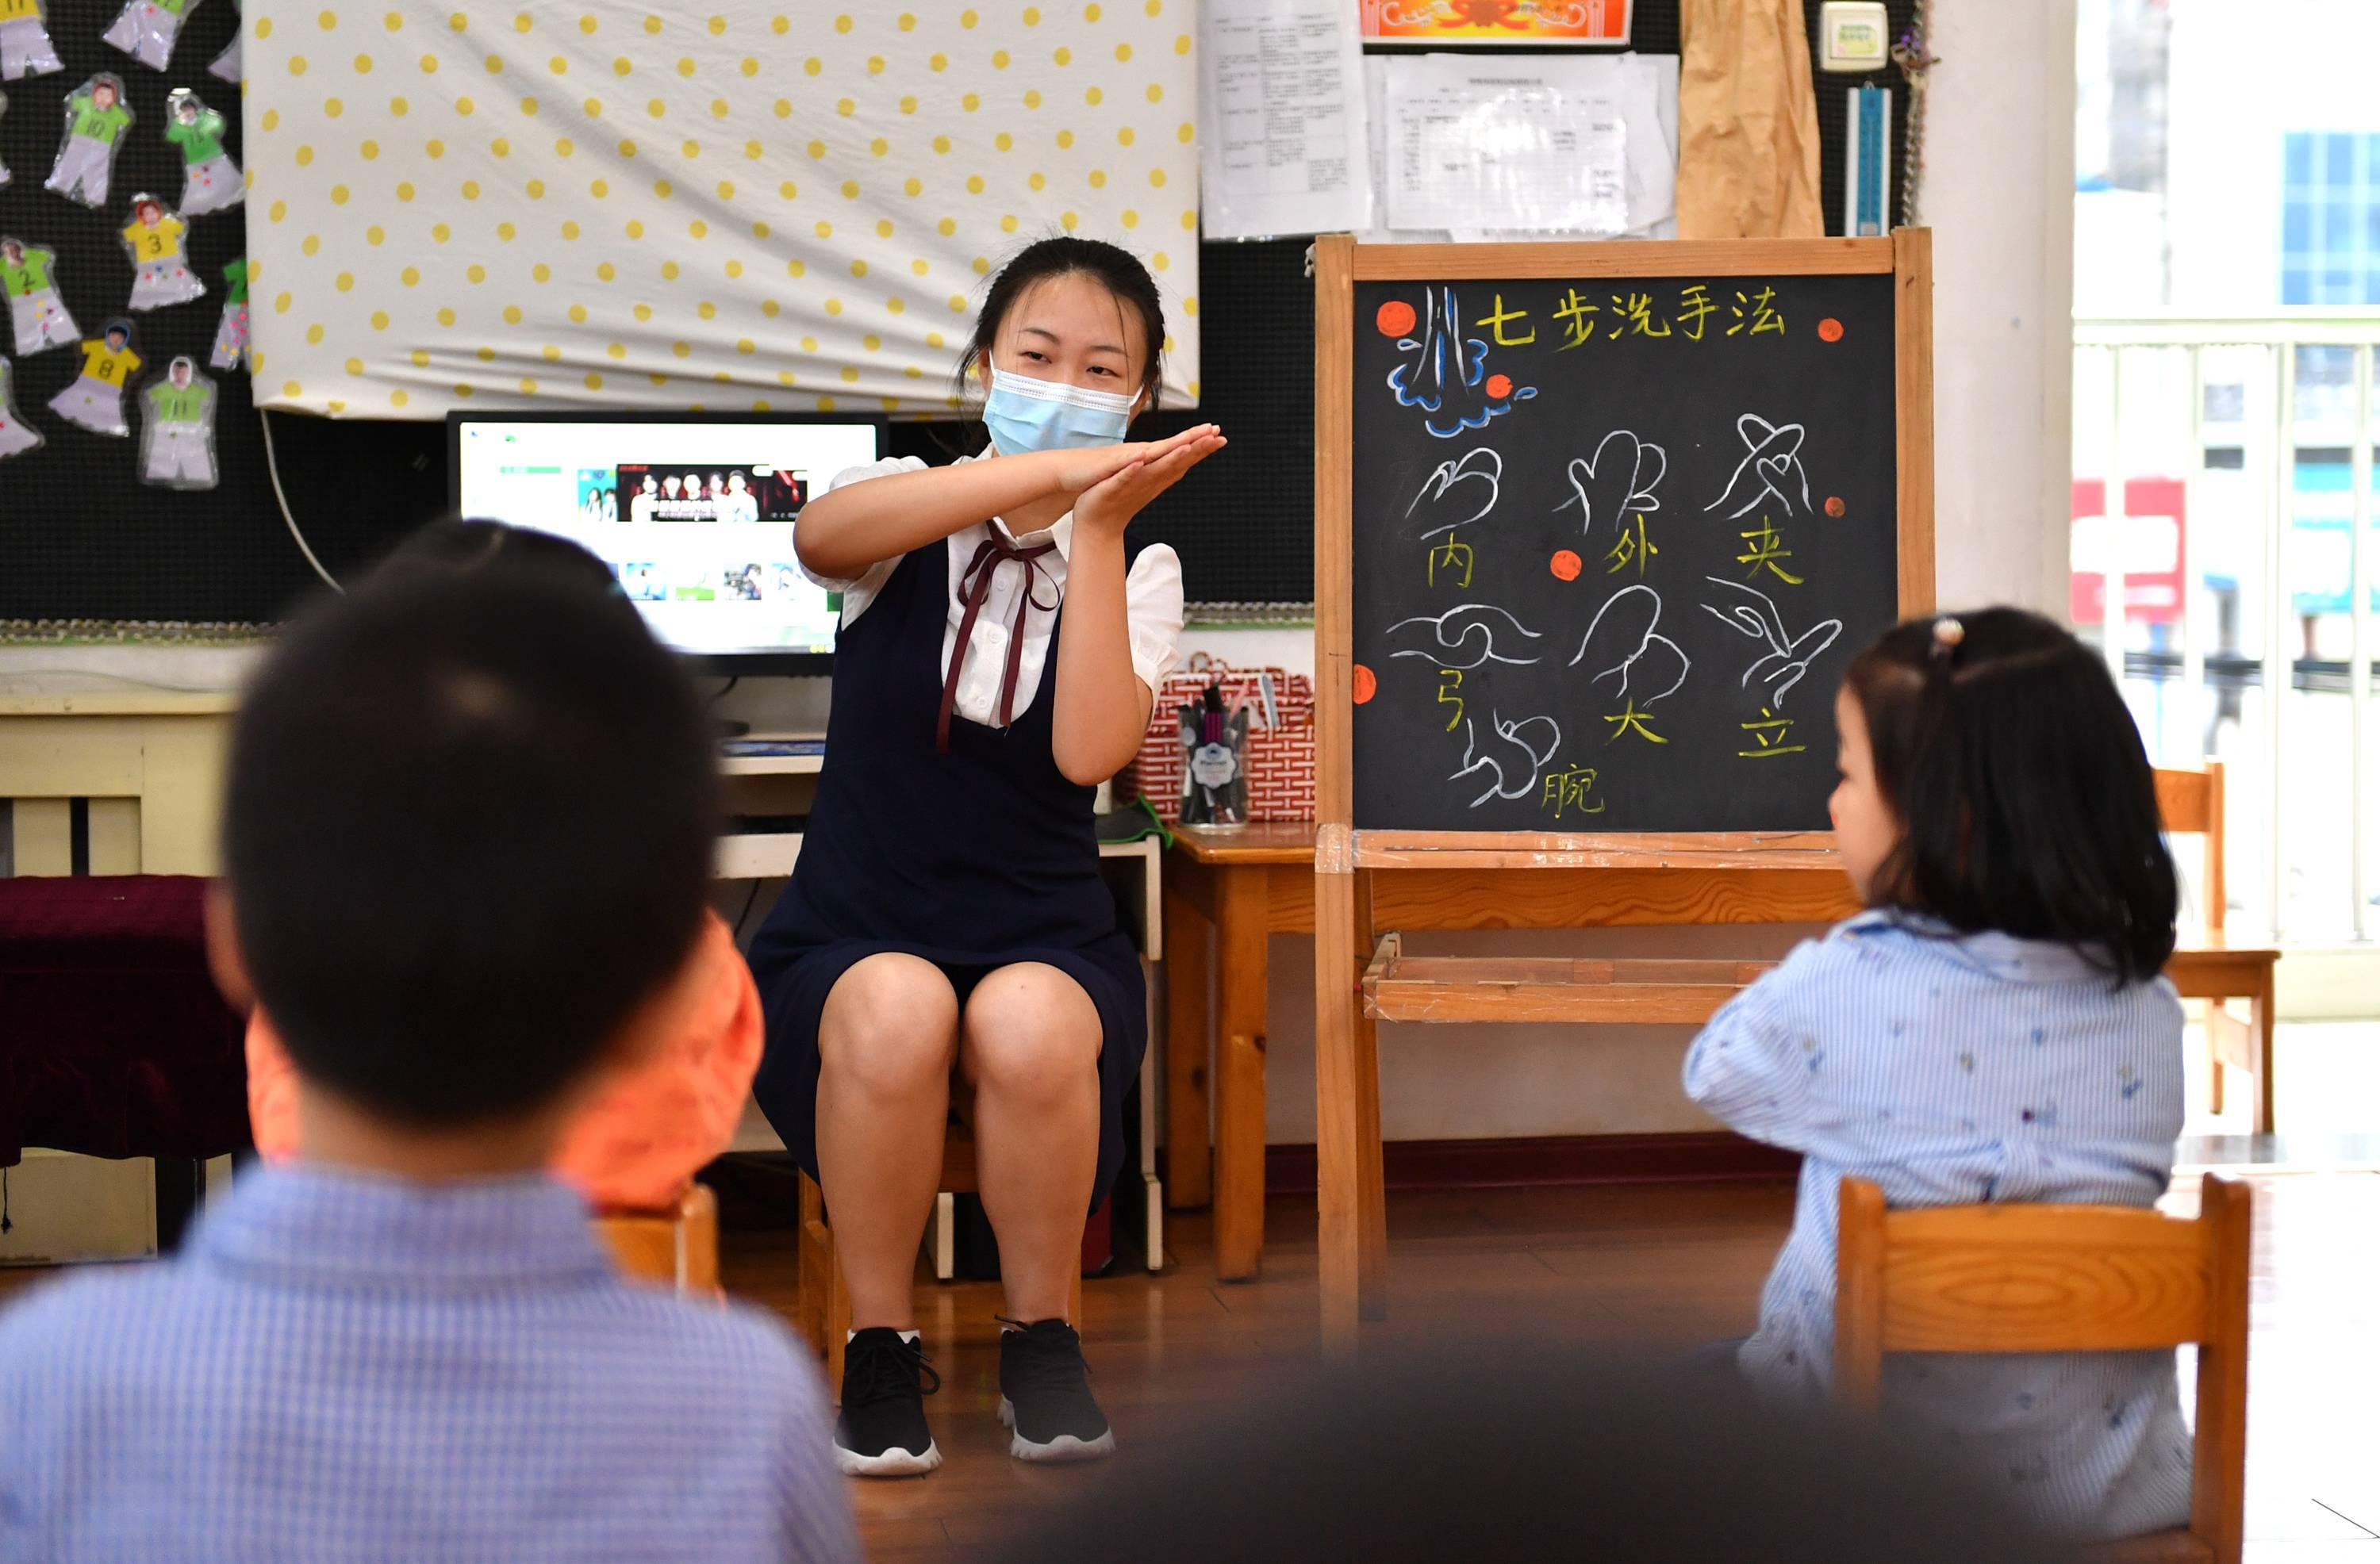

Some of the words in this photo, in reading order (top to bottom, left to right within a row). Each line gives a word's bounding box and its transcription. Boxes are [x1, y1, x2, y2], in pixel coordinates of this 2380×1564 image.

[147, 232, 163, 255] 3
[18, 269, 36, 288] 2
[1476, 286, 1784, 351] 七步洗手法
[98, 360, 115, 381] 8
[174, 398, 188, 417] 11
[1429, 532, 1473, 588] 内
[1606, 513, 1658, 577] 外
[1736, 516, 1804, 585] 夹
[1438, 669, 1464, 732] 弓
[1604, 698, 1669, 746] 大
[1738, 707, 1806, 757] 立
[1541, 764, 1606, 818] 腕
